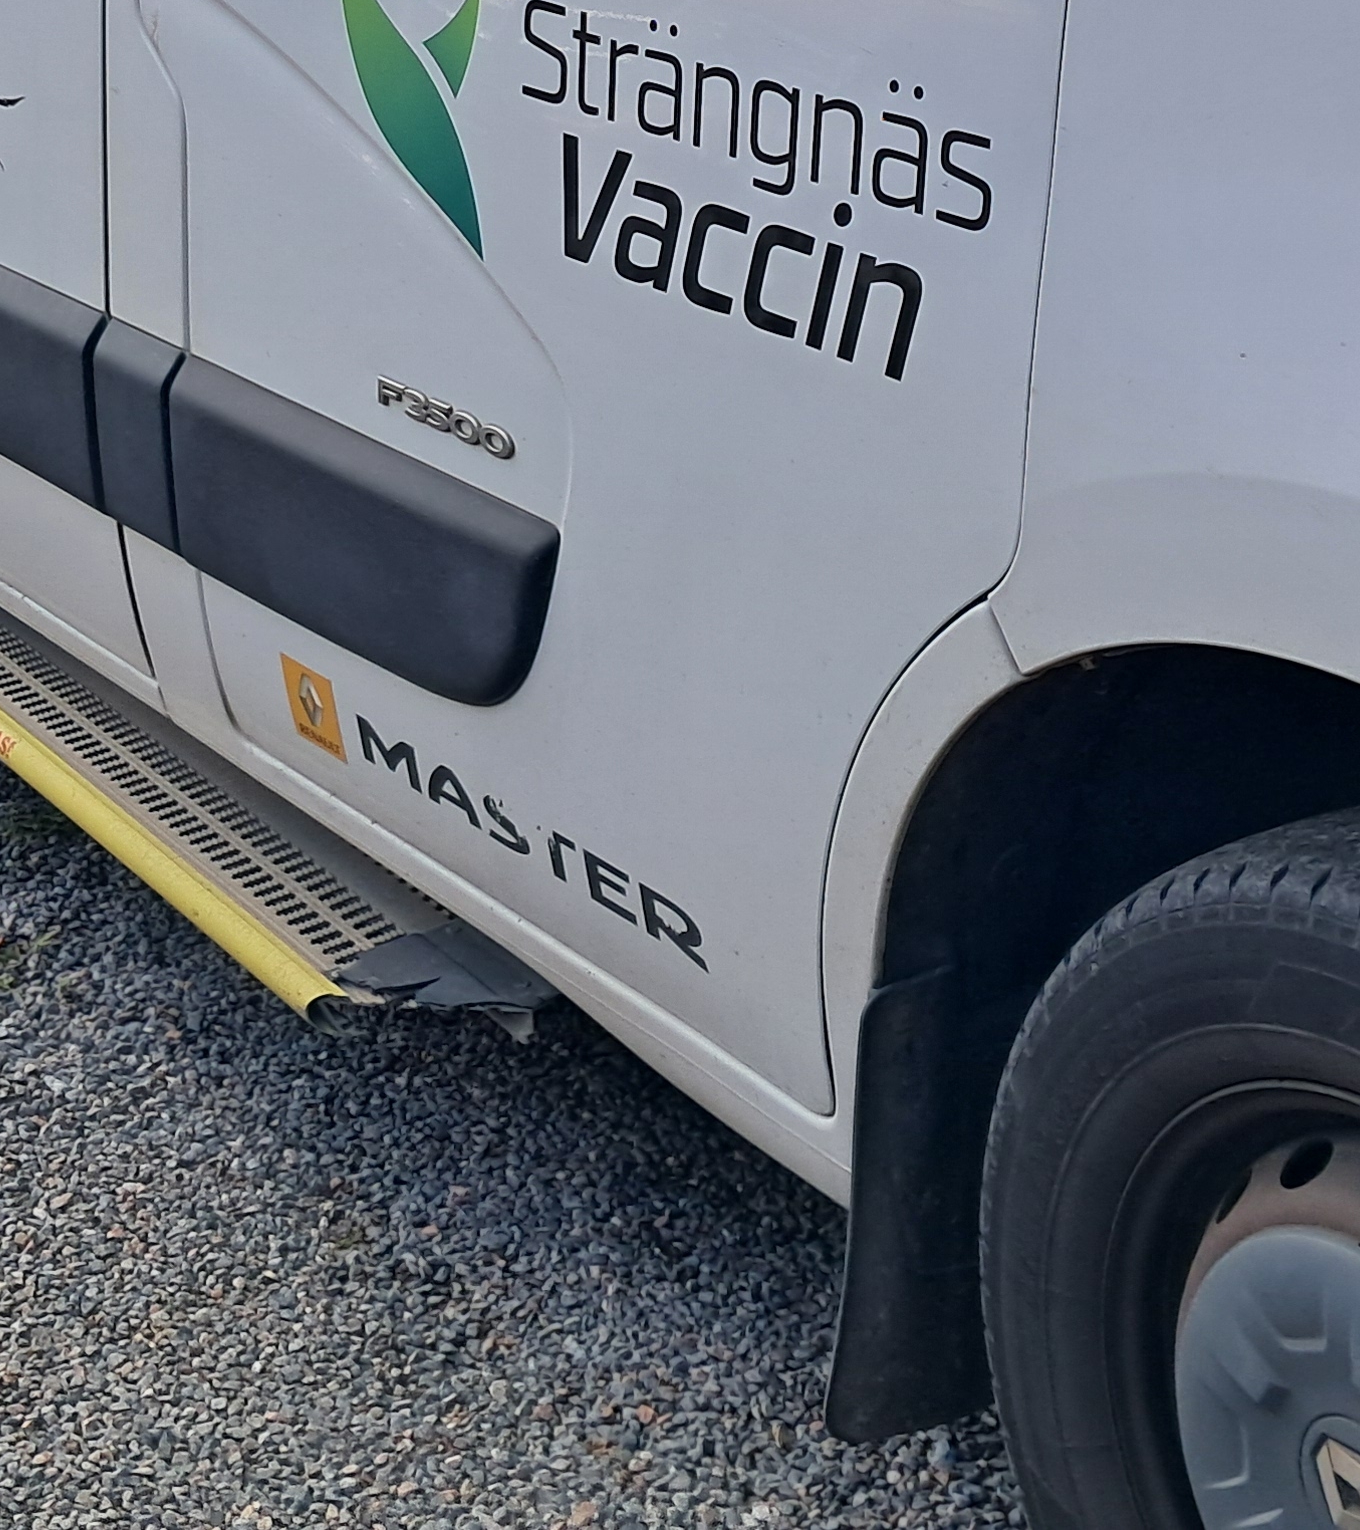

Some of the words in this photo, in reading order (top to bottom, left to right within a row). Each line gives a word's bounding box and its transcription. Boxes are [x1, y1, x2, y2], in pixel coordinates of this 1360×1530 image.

[561, 132, 925, 382] Vaccin
[375, 373, 516, 460] F3500
[355, 712, 711, 974] MASTER
